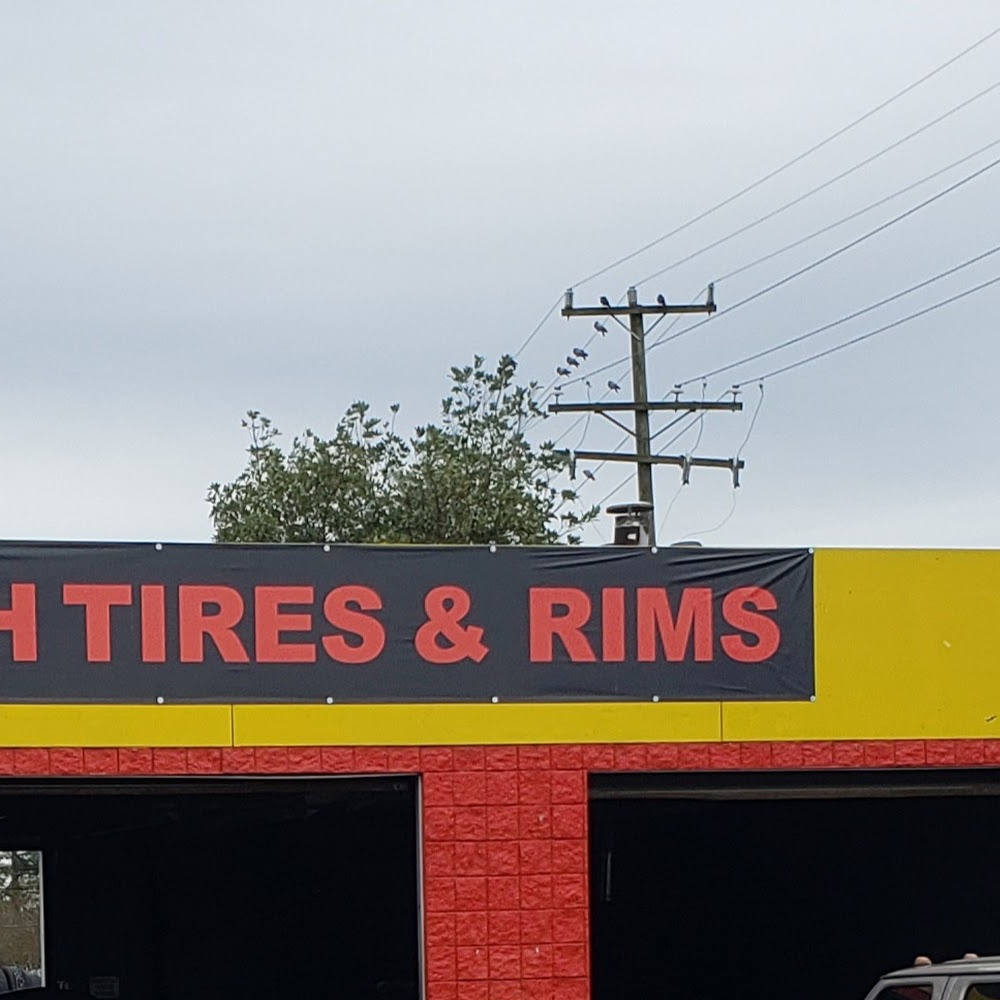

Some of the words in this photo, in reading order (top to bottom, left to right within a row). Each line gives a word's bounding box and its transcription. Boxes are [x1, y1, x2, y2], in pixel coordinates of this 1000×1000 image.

[62, 583, 386, 664] TIRES
[414, 585, 489, 664] &
[529, 585, 780, 664] RIMS
